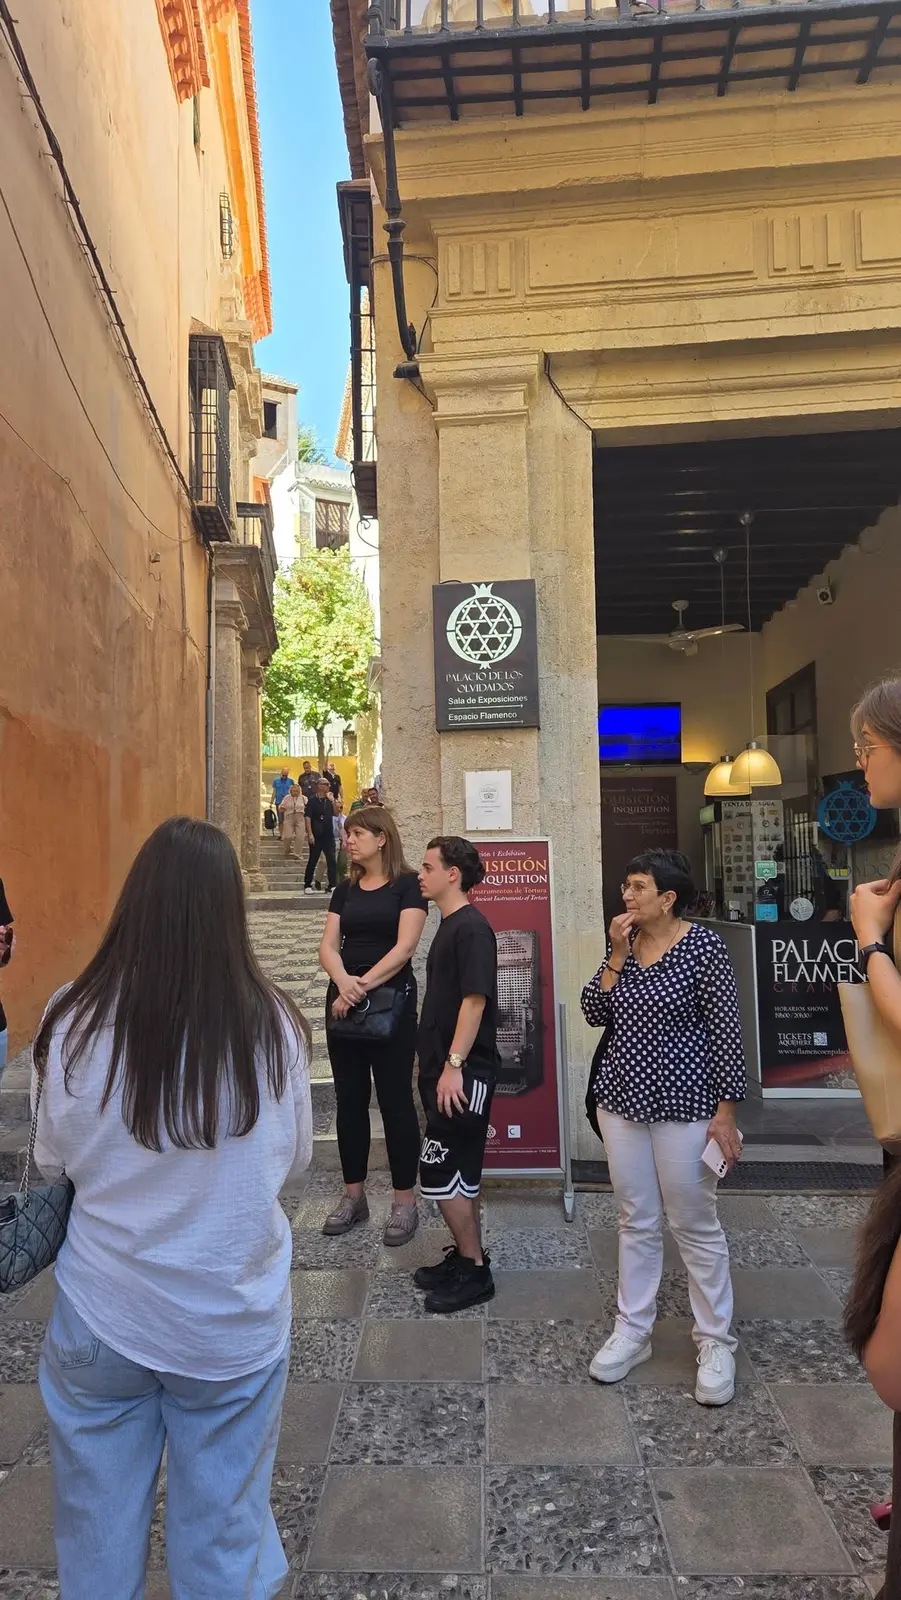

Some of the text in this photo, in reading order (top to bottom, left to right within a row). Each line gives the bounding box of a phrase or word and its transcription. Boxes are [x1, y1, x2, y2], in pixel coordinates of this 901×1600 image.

[445, 670, 524, 682] PALACIO DE LOS
[456, 682, 515, 693] OLVIDADOS
[448, 697, 465, 705] Sala
[478, 695, 528, 704] Exposiciones
[448, 711, 518, 721] Espacio Flamenco
[613, 805, 670, 814] INQUISITION
[485, 857, 547, 872] ISICIÓN
[524, 886, 547, 894] Tortura
[770, 938, 859, 963] PALACI
[773, 963, 869, 983] FLAMEN
[773, 982, 833, 993] GRAN
